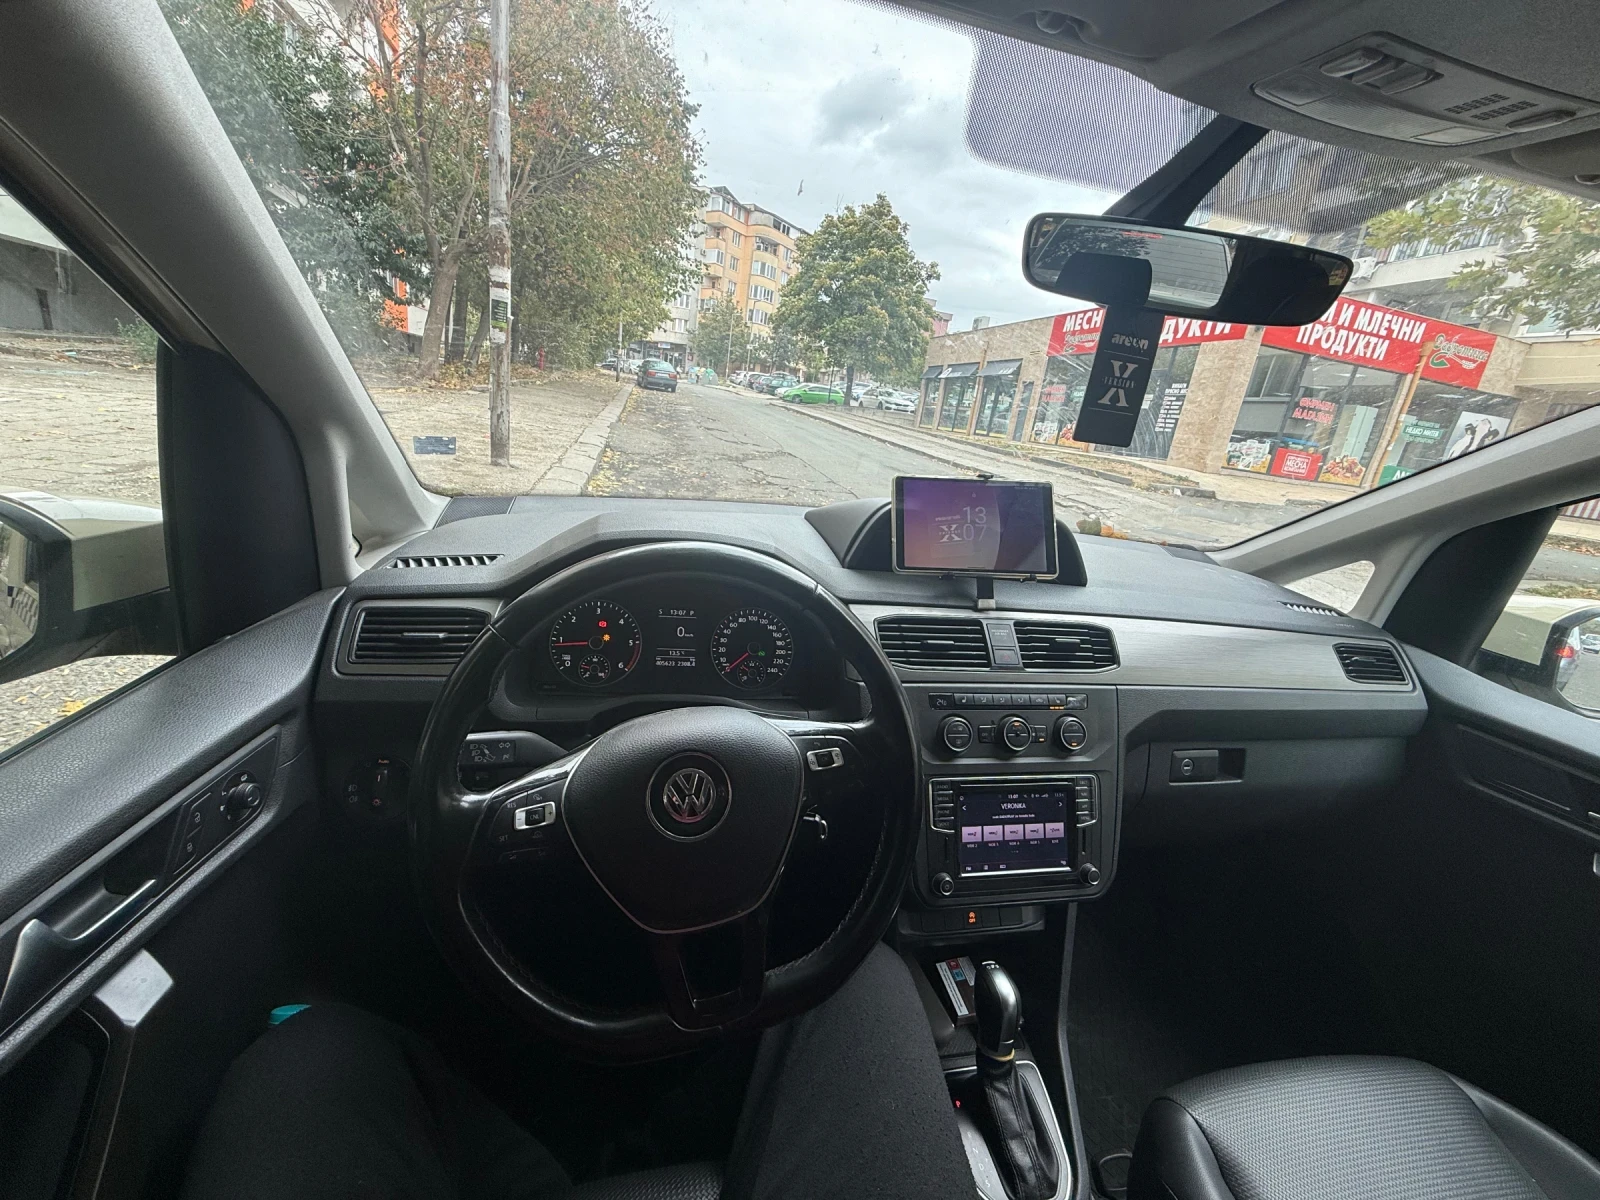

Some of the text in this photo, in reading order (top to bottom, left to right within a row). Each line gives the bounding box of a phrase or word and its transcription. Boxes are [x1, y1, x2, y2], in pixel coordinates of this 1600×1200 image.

[1062, 309, 1232, 343] МЕСН ДУКТИ
[1353, 307, 1427, 344] МЛЕЧНИ
[1296, 323, 1390, 361] ПРОДУКТИ
[962, 506, 987, 524] 13
[962, 523, 987, 542] 07
[596, 607, 601, 615] 3
[571, 615, 577, 623] 2
[676, 626, 685, 637] 0
[628, 639, 634, 647] 5
[618, 661, 624, 669] 6
